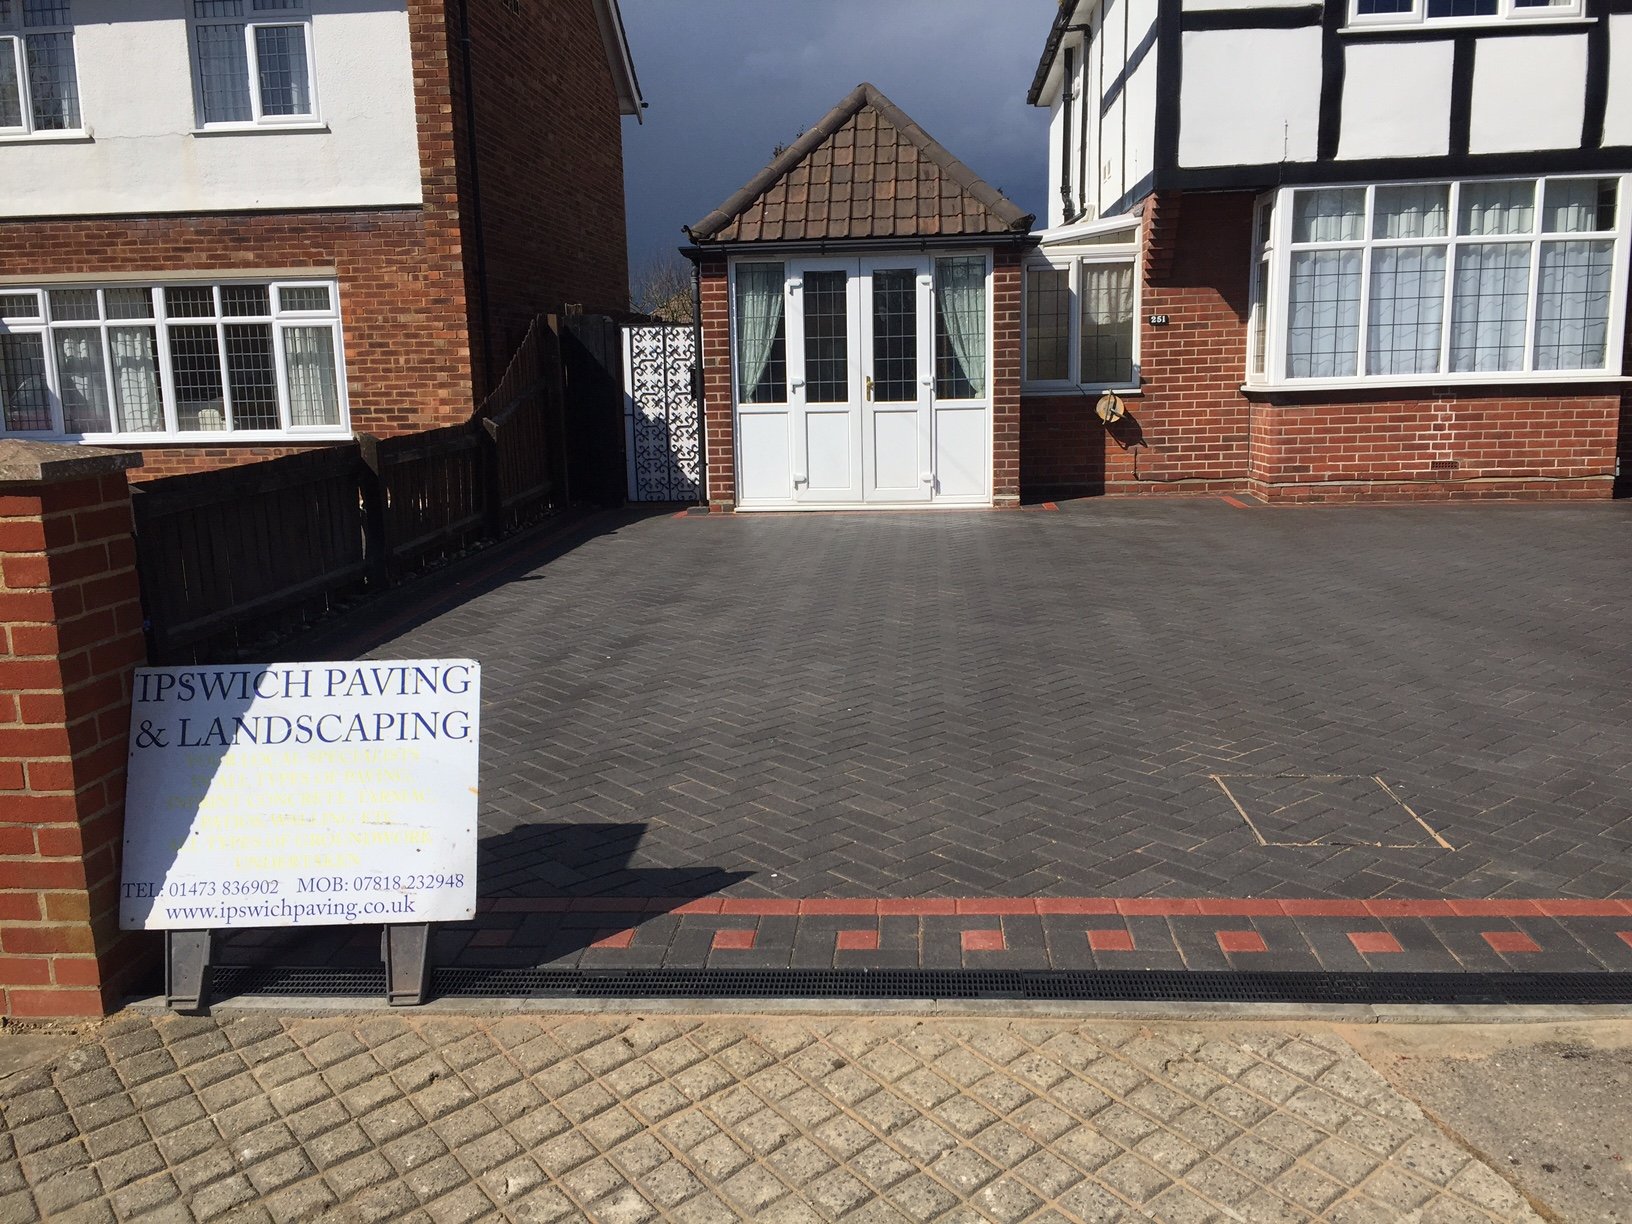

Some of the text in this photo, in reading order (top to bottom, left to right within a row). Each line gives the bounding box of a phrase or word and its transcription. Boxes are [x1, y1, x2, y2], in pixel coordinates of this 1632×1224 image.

[138, 665, 471, 702] IPSWICH PAVING
[135, 711, 471, 749] & LANDSCAPING
[169, 881, 216, 897] 01473
[222, 879, 279, 896] 836902
[296, 876, 348, 893] MOB:
[353, 875, 401, 892] 07818
[405, 873, 464, 890] 232948
[166, 894, 416, 924] www.ipswichpaving.co.uk
